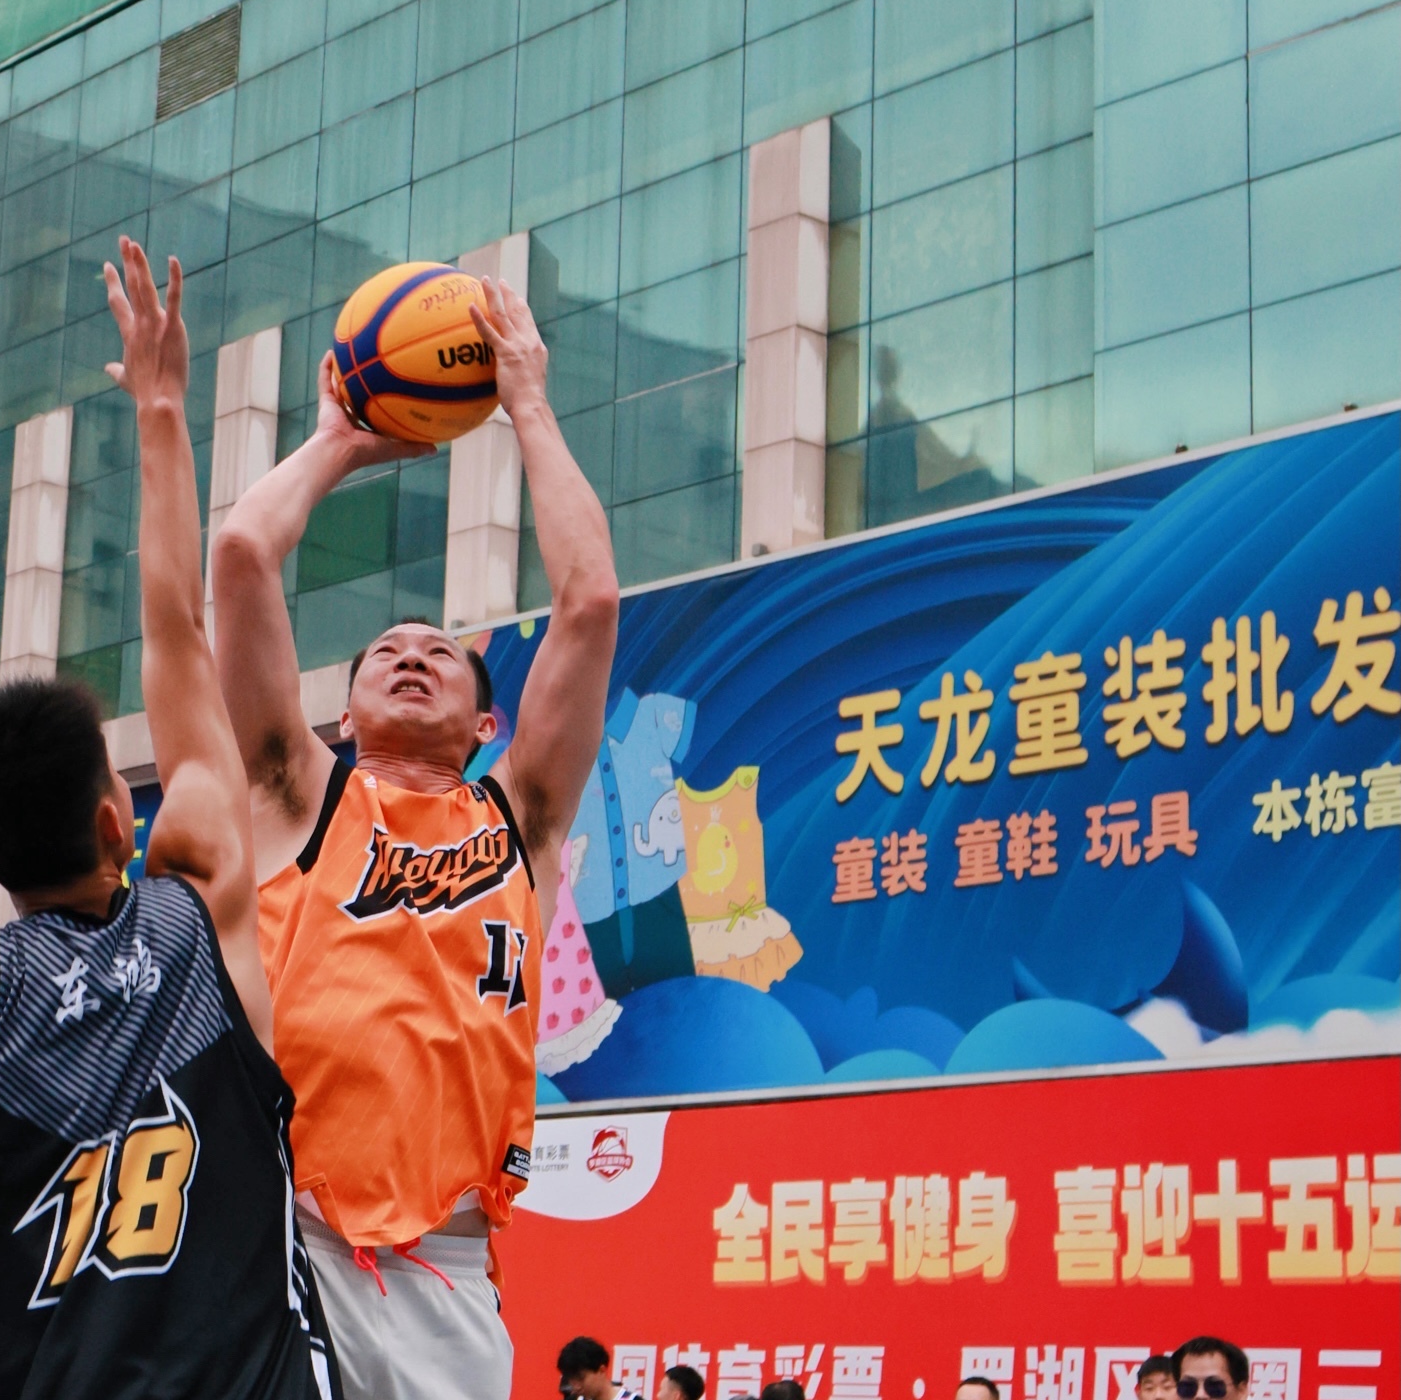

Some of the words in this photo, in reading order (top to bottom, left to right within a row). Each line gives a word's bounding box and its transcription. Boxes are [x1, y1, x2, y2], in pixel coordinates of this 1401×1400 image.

[437, 340, 496, 369] lten
[835, 586, 1401, 803] 天龙童装批发
[831, 829, 928, 904] 童装
[954, 809, 1059, 888] 童鞋
[1085, 791, 1199, 869] 玩具
[1252, 761, 1401, 843] 本栋富
[14, 1095, 200, 1309] 18
[713, 1173, 1017, 1287] 全民享健身
[1053, 1152, 1401, 1288] 喜迎十五运
